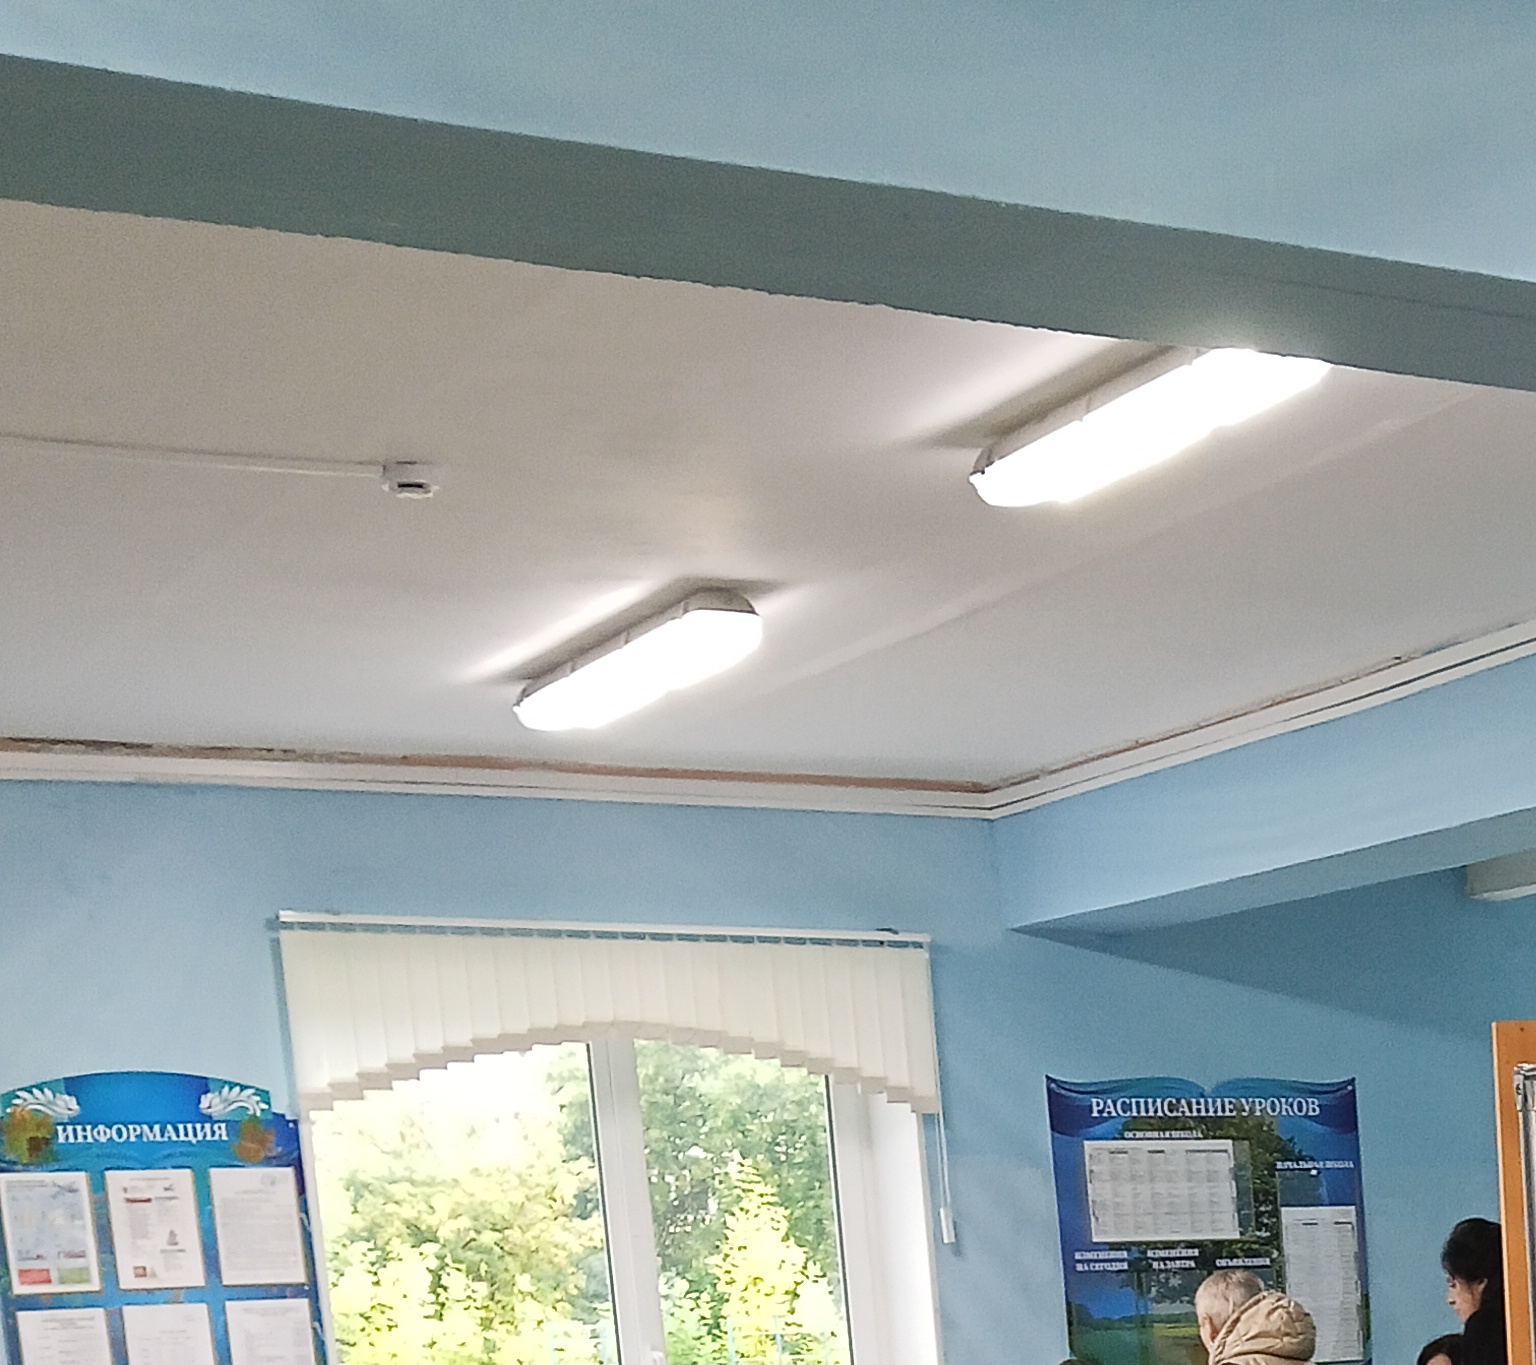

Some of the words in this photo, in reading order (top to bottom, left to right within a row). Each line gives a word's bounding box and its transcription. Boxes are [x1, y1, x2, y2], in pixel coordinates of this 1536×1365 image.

[1090, 1097, 1236, 1117] РАСПИСАНИЕ
[1241, 1097, 1321, 1117] УРОКОВ
[56, 1122, 229, 1144] ИНФОРМАЦИЯ
